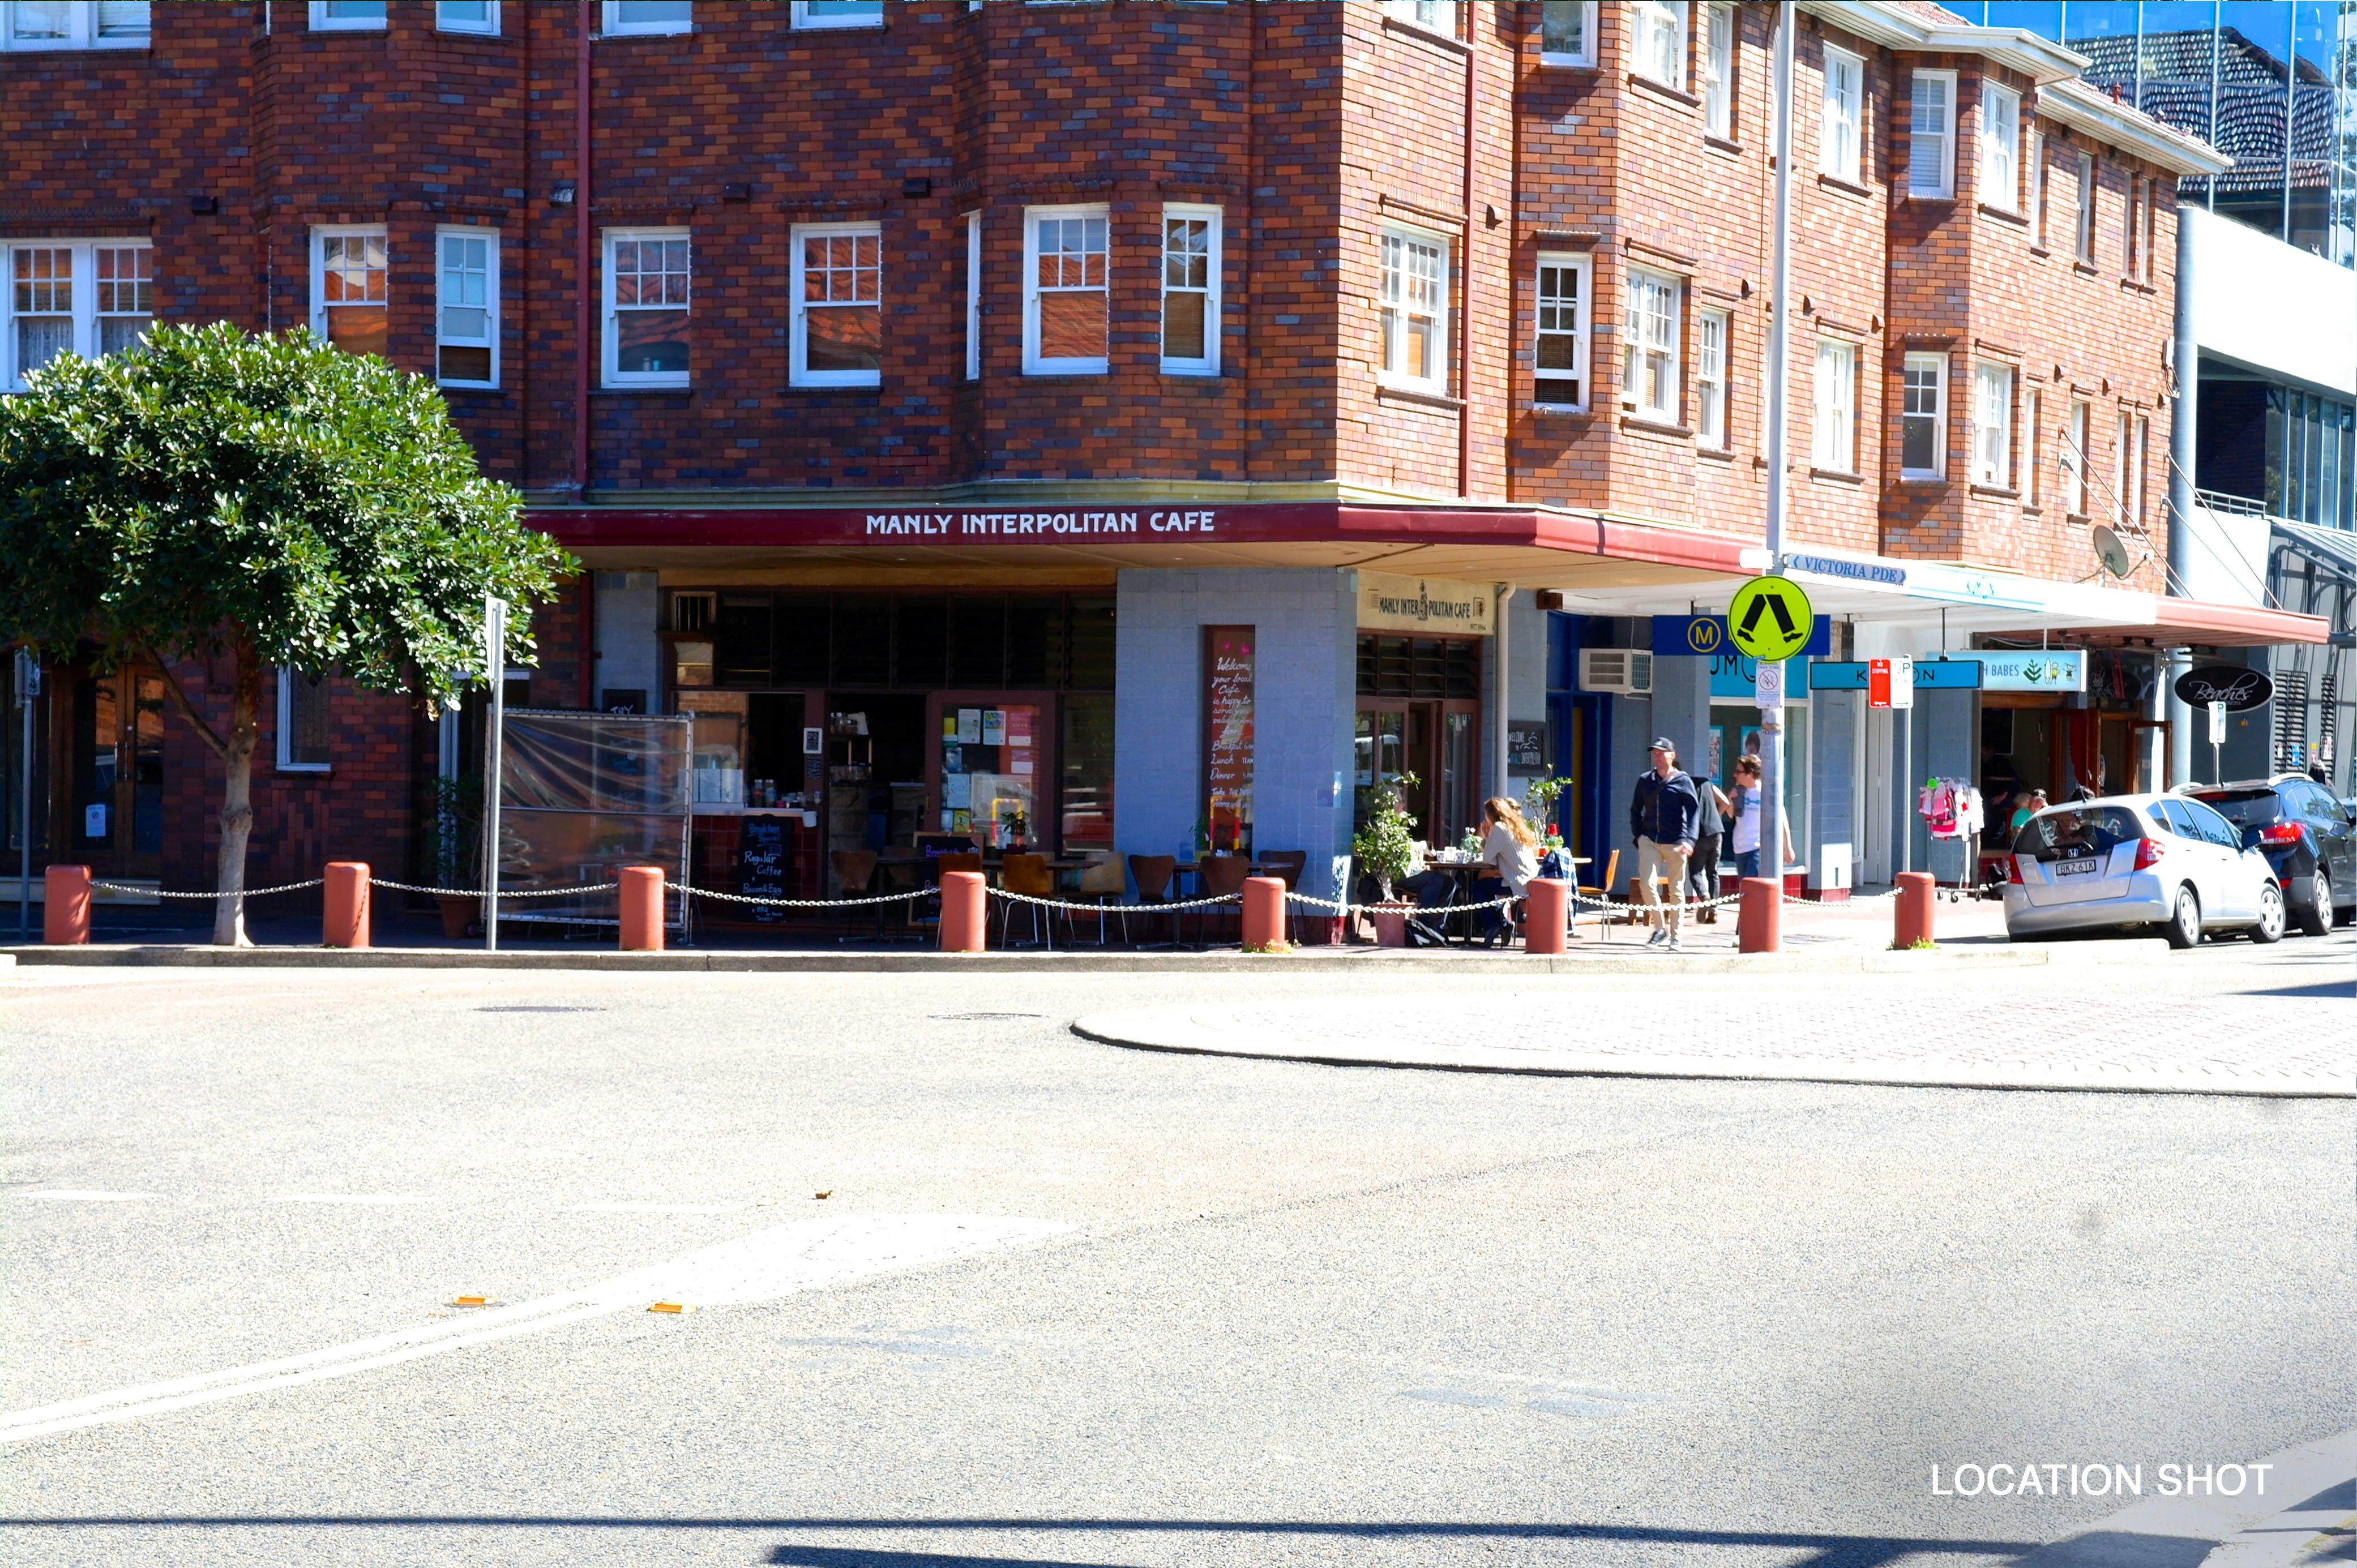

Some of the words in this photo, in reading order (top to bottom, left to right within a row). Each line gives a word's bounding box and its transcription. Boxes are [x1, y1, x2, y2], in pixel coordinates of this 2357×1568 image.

[866, 515, 952, 534] MANLY
[961, 512, 1137, 534] INTERPOLITAN
[1804, 556, 1866, 578] VICTORIA
[1871, 567, 1897, 582] PDE
[1379, 597, 1399, 614] MANLY
[1400, 599, 1418, 615] INTER
[1428, 600, 1453, 618] POLITAN
[1695, 626, 1713, 644] M
[1217, 657, 1252, 671] Welcome
[1991, 665, 2019, 676] BABES
[1212, 676, 1231, 688] your
[1233, 672, 1251, 683] local
[2189, 672, 2259, 701] Beaches
[610, 704, 634, 714] TRY
[1221, 696, 1241, 708] happy
[1242, 695, 1251, 705] to
[1210, 753, 1234, 765] Lunch
[1210, 768, 1235, 780] Dinner
[744, 850, 777, 866] Regular
[756, 864, 782, 876] Coffee
